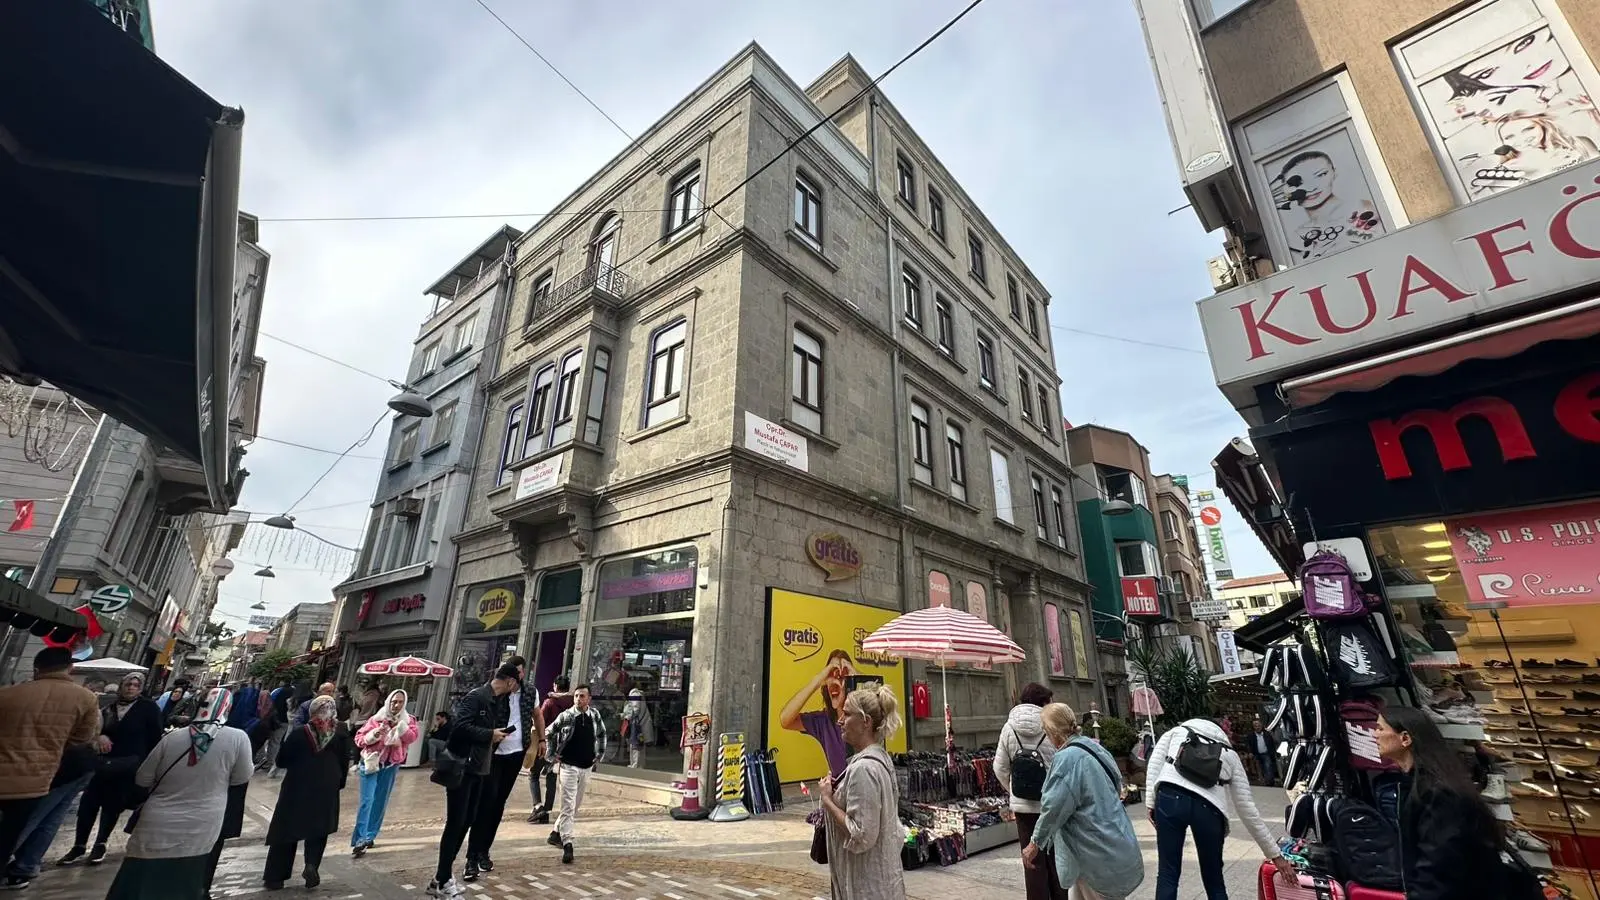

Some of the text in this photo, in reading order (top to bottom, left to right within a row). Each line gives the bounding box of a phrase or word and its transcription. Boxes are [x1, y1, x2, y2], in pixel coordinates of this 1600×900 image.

[754, 427, 779, 444] Mustafa
[779, 439, 799, 453] ÇAPAR
[1497, 527, 1544, 544] U.S.
[1552, 537, 1594, 547] SINCE
[815, 538, 859, 566] gratis
[1134, 581, 1143, 595] 1.
[479, 592, 507, 618] gratis
[1127, 597, 1156, 612] NOTER
[783, 627, 819, 646] gratis
